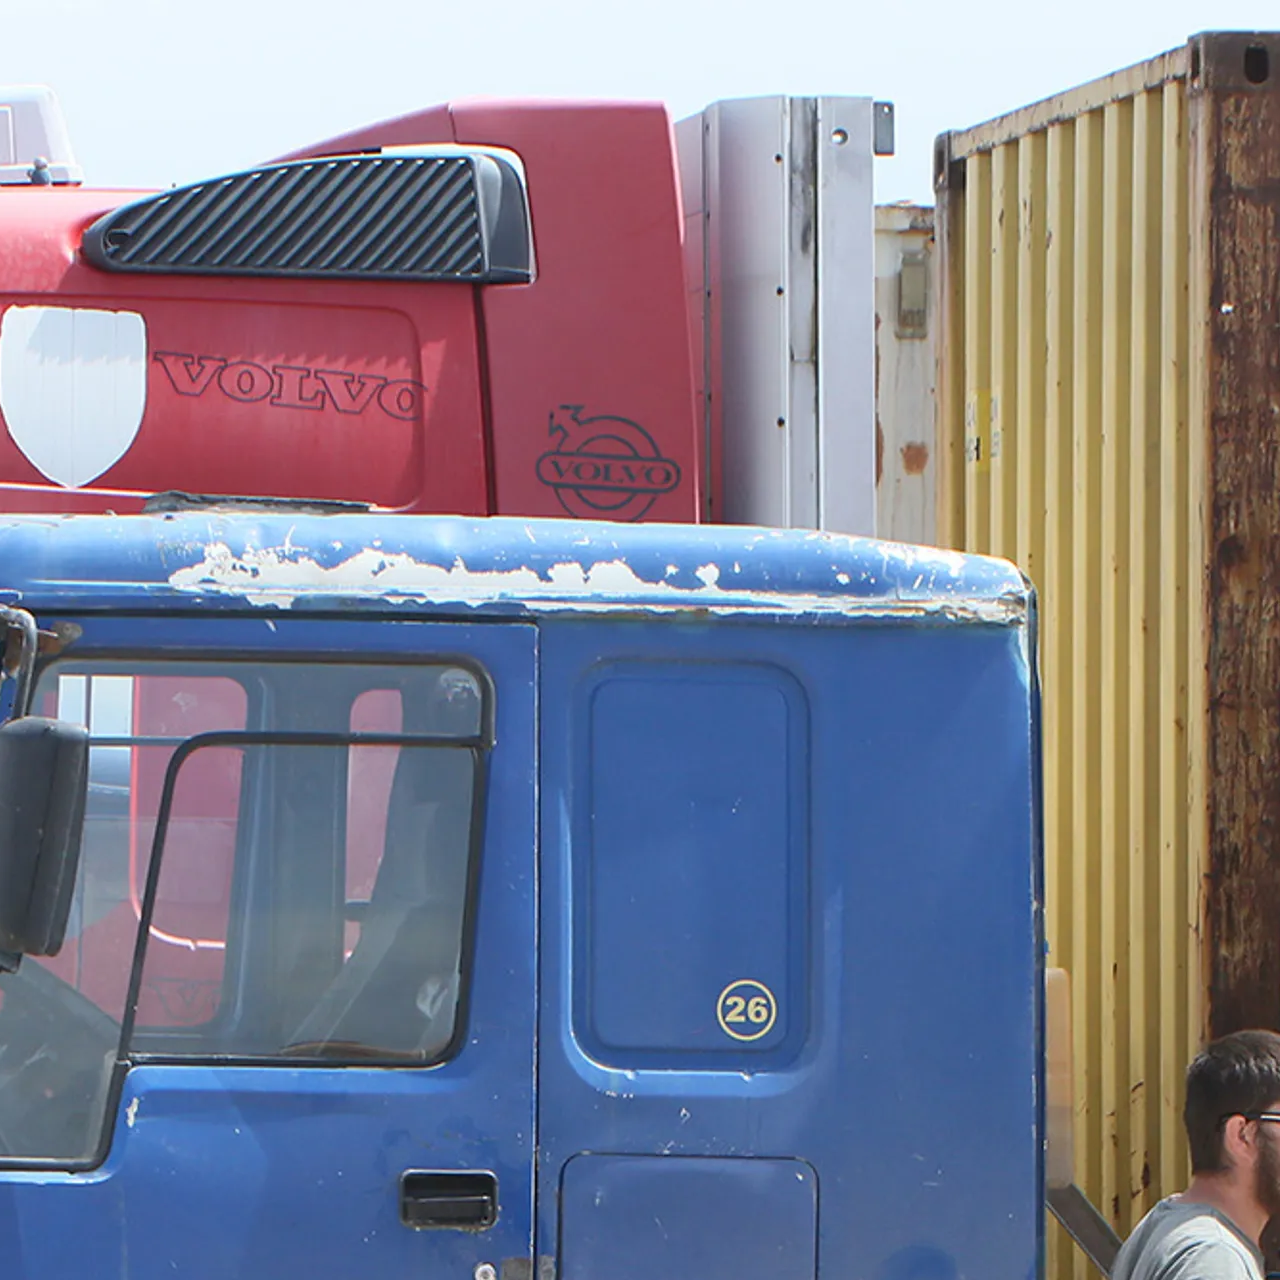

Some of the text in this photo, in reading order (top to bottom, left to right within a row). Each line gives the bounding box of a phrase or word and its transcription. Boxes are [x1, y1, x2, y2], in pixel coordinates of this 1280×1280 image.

[153, 351, 428, 421] VOLVO
[551, 460, 673, 485] VOLVO
[724, 995, 769, 1023] 26
